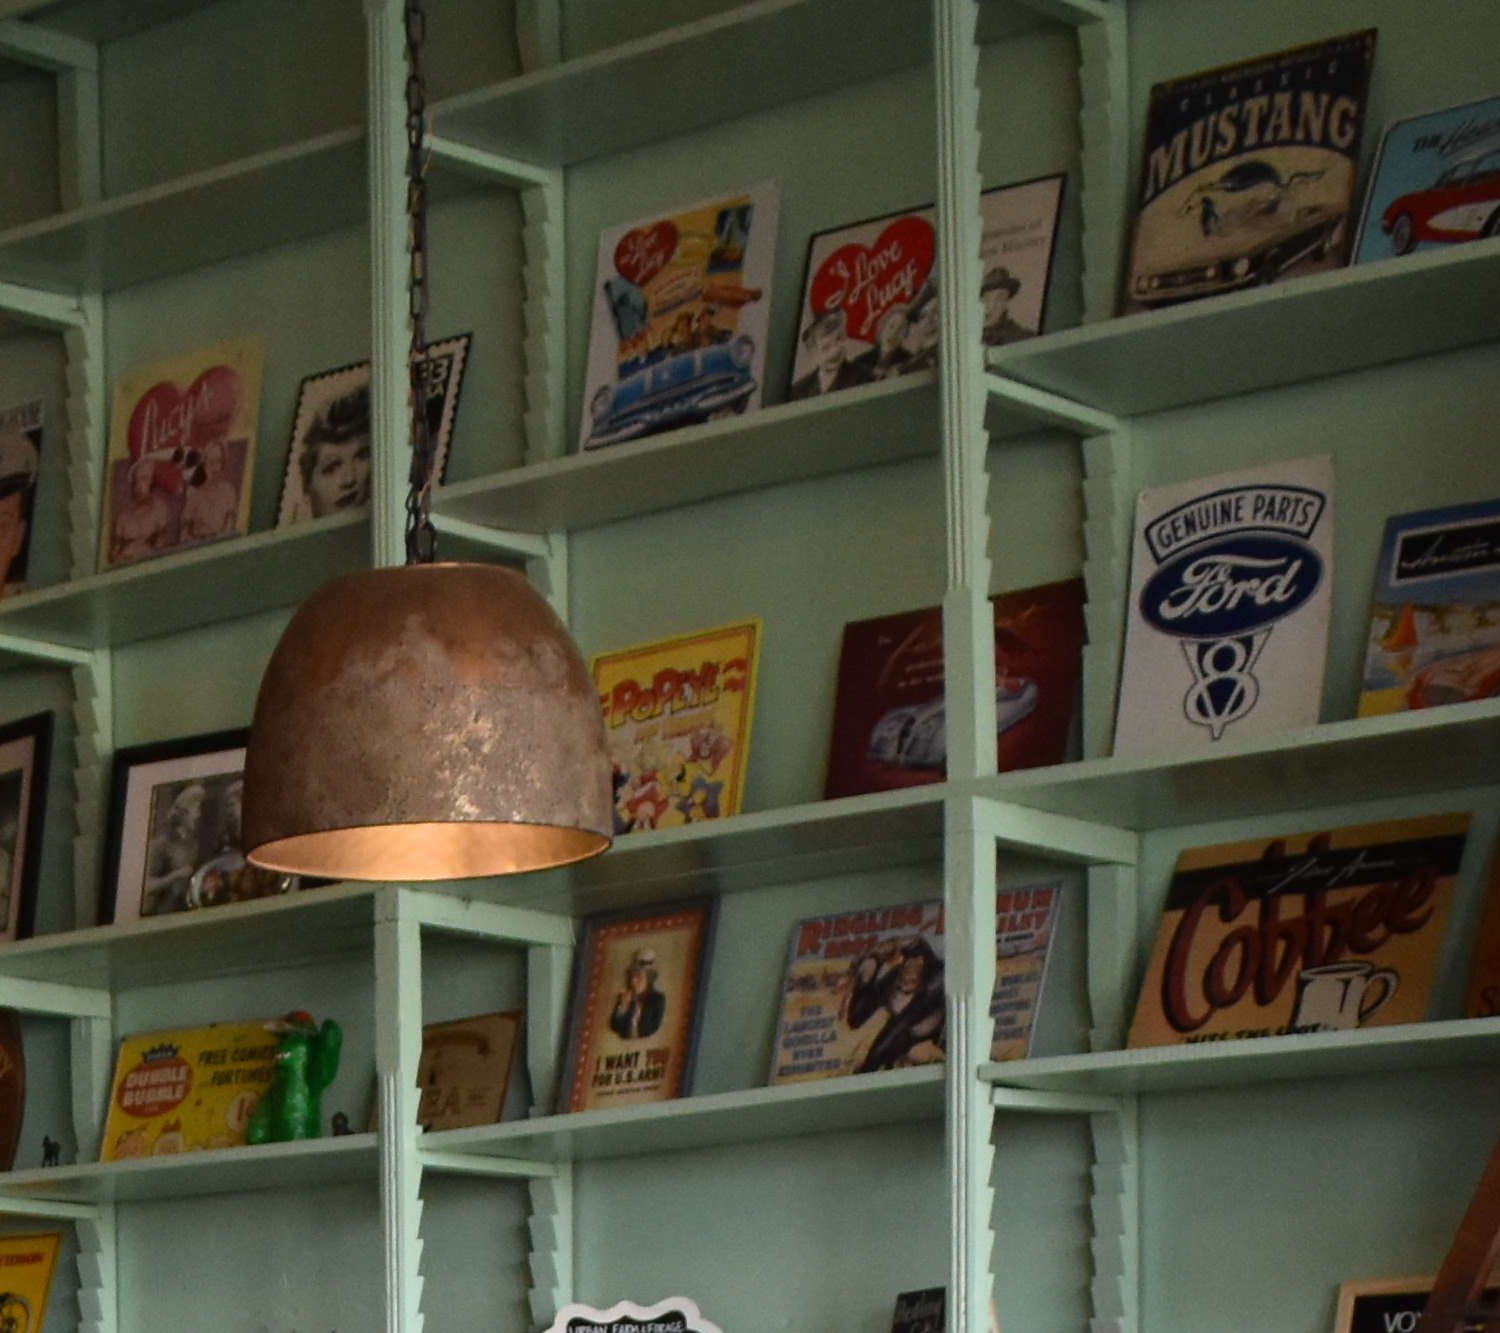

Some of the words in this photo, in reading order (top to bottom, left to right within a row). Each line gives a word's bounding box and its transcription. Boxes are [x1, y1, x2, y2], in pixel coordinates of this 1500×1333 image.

[1146, 90, 1358, 200] MUSTANG
[849, 239, 903, 306] Love
[859, 256, 917, 336] Lucy
[1156, 496, 1245, 549] GENUINE
[1251, 494, 1315, 527] PARTS
[1158, 553, 1303, 620] Ford
[605, 1051, 641, 1071] WANT
